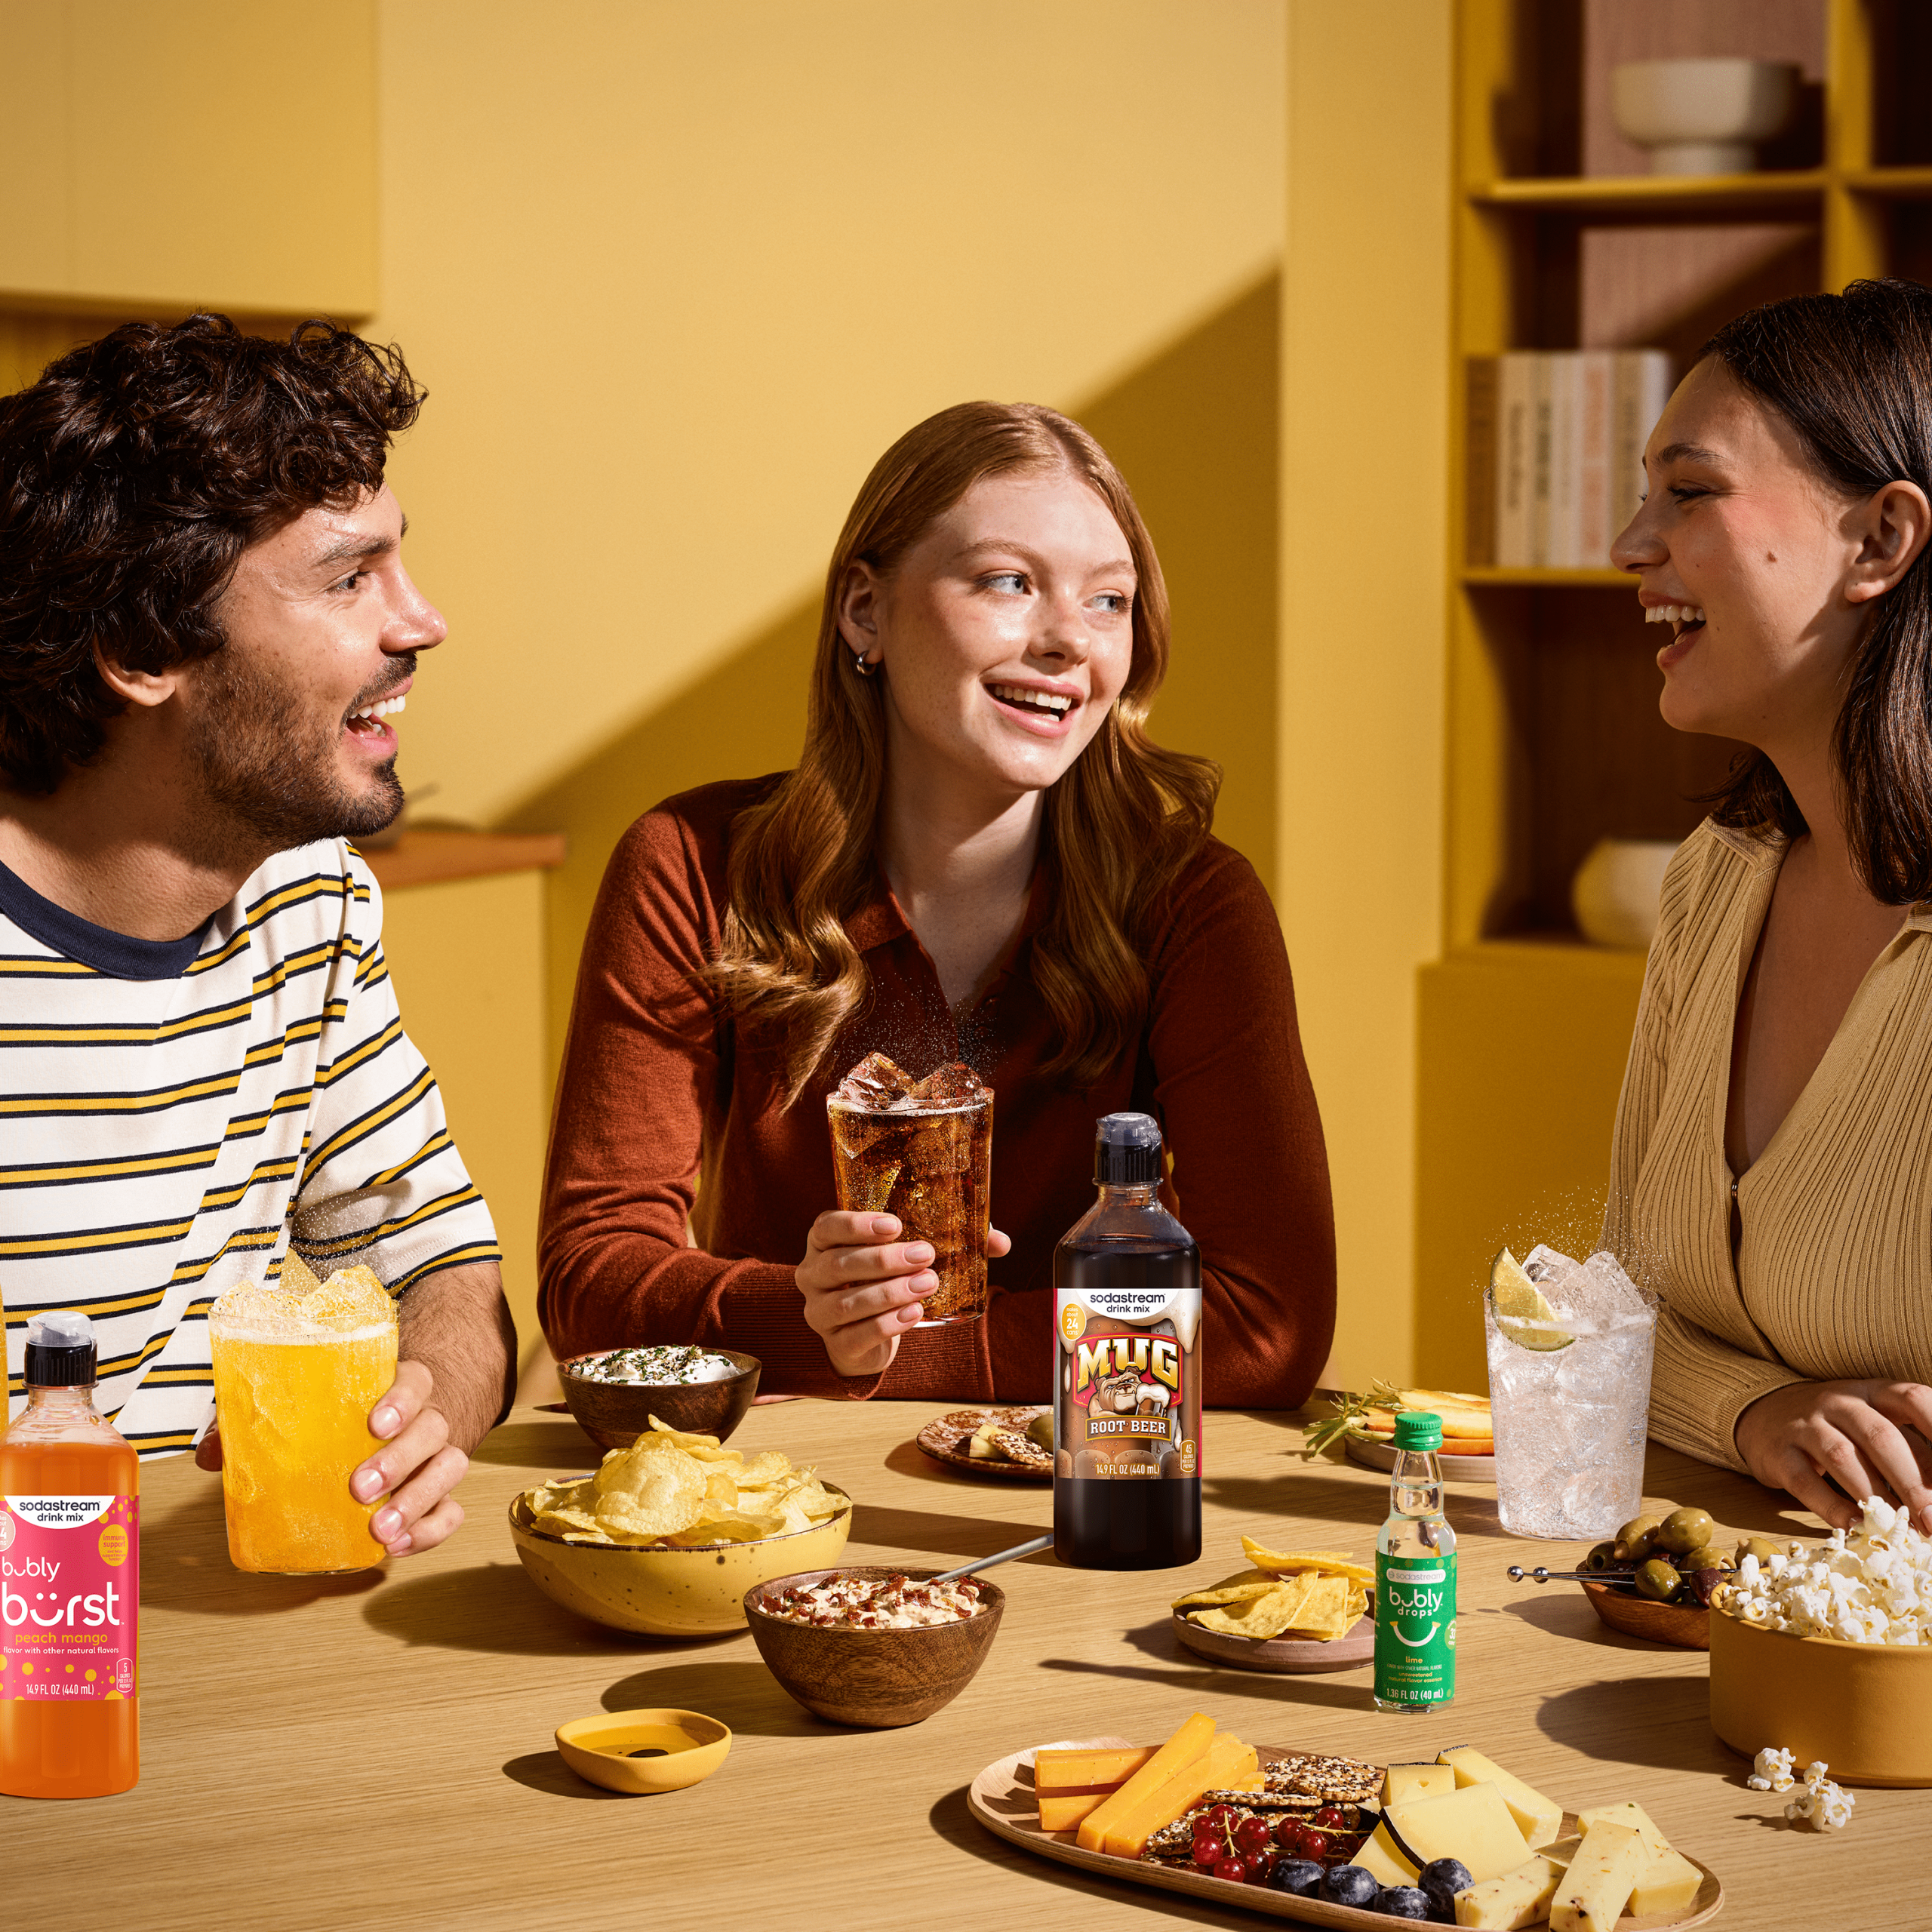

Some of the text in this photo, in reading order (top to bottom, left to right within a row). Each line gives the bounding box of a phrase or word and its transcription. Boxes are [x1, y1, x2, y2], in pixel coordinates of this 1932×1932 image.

[1090, 1293, 1164, 1303] sodastream
[1066, 1318, 1078, 1329] 24
[1077, 1338, 1179, 1392] MUG
[1091, 1420, 1166, 1434] ROOT BEER
[1186, 1444, 1192, 1454] 45
[1096, 1464, 1160, 1475] 14.9 FL OZ (440 mL)
[20, 1500, 100, 1511] sodastream
[37, 1513, 84, 1521] drink mix
[0, 1527, 7, 1539] 4
[2, 1556, 60, 1583] bubly
[1398, 1606, 1432, 1619] drops
[15, 1632, 108, 1646] peach mango
[124, 1663, 127, 1672] 5
[26, 1684, 94, 1695] 14.9 FL OZ (440 mL)
[1387, 1687, 1444, 1700] 1.36 FL OZ (40 mL)
